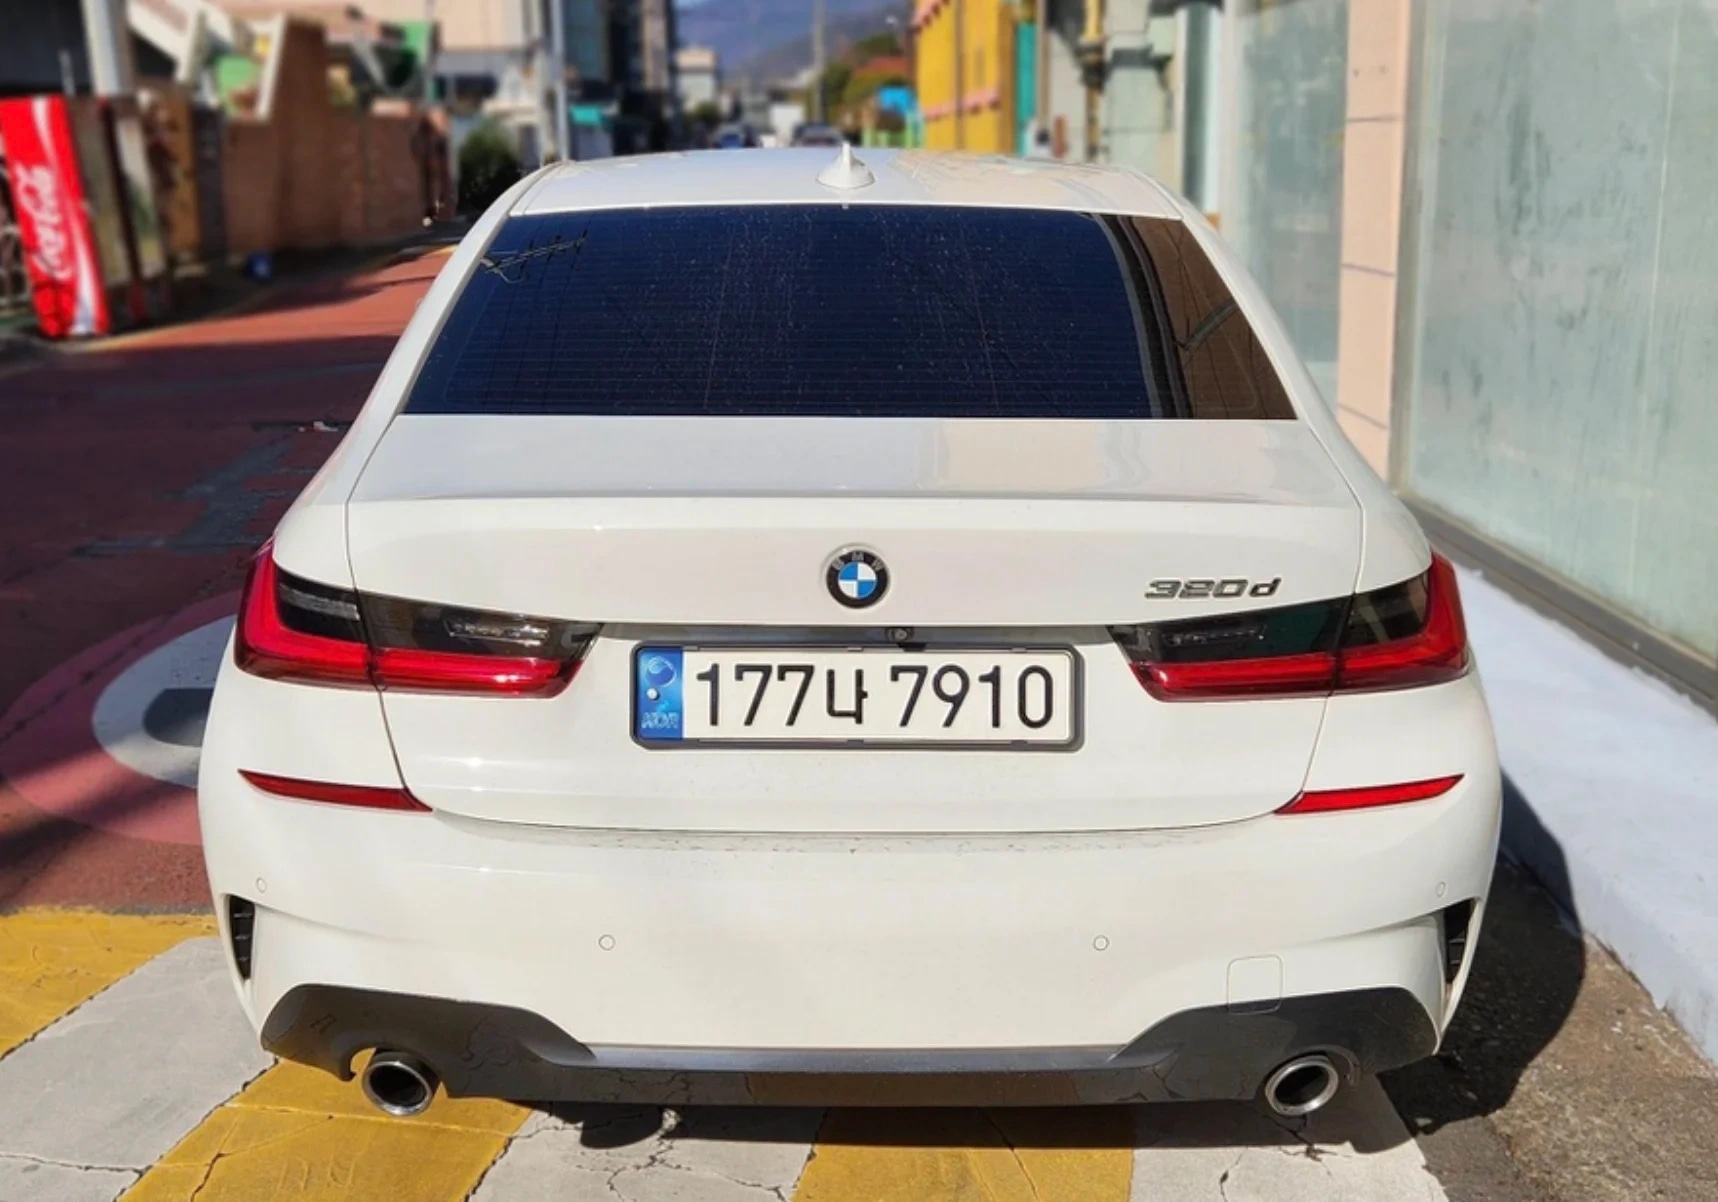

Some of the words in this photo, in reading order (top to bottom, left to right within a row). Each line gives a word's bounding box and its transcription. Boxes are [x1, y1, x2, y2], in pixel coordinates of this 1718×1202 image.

[1144, 577, 1281, 599] 320d
[696, 663, 868, 727] 177나
[890, 664, 1053, 729] 7910
